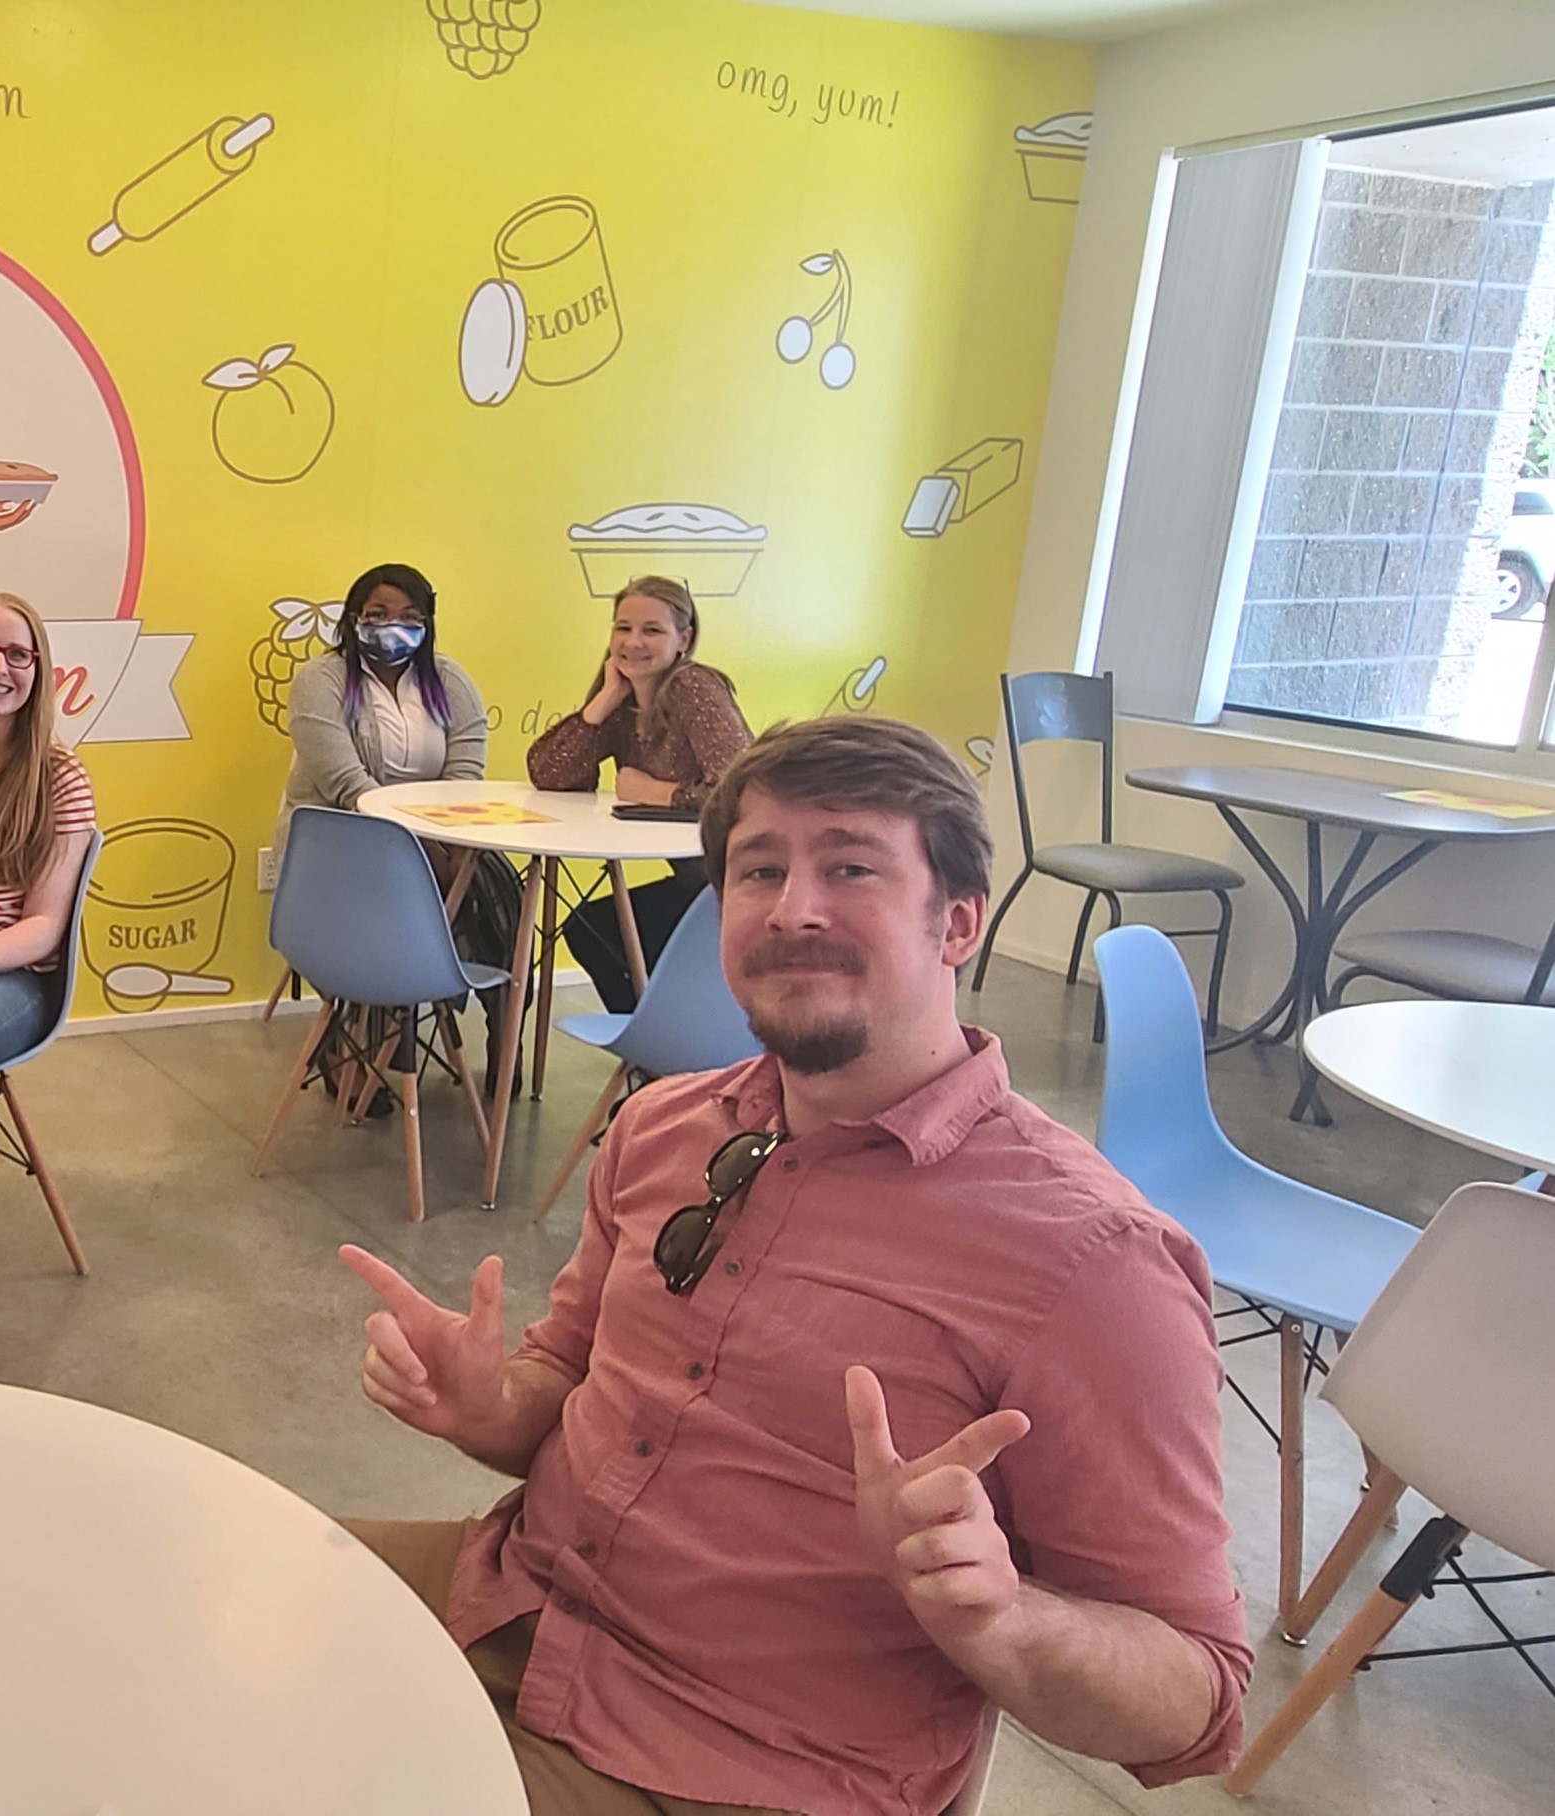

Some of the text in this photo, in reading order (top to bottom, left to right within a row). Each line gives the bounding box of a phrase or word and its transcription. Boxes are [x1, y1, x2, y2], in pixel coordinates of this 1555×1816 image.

[716, 61, 900, 129] omg, yum!
[527, 285, 609, 341] FLOUR
[108, 918, 196, 950] SUGAR
